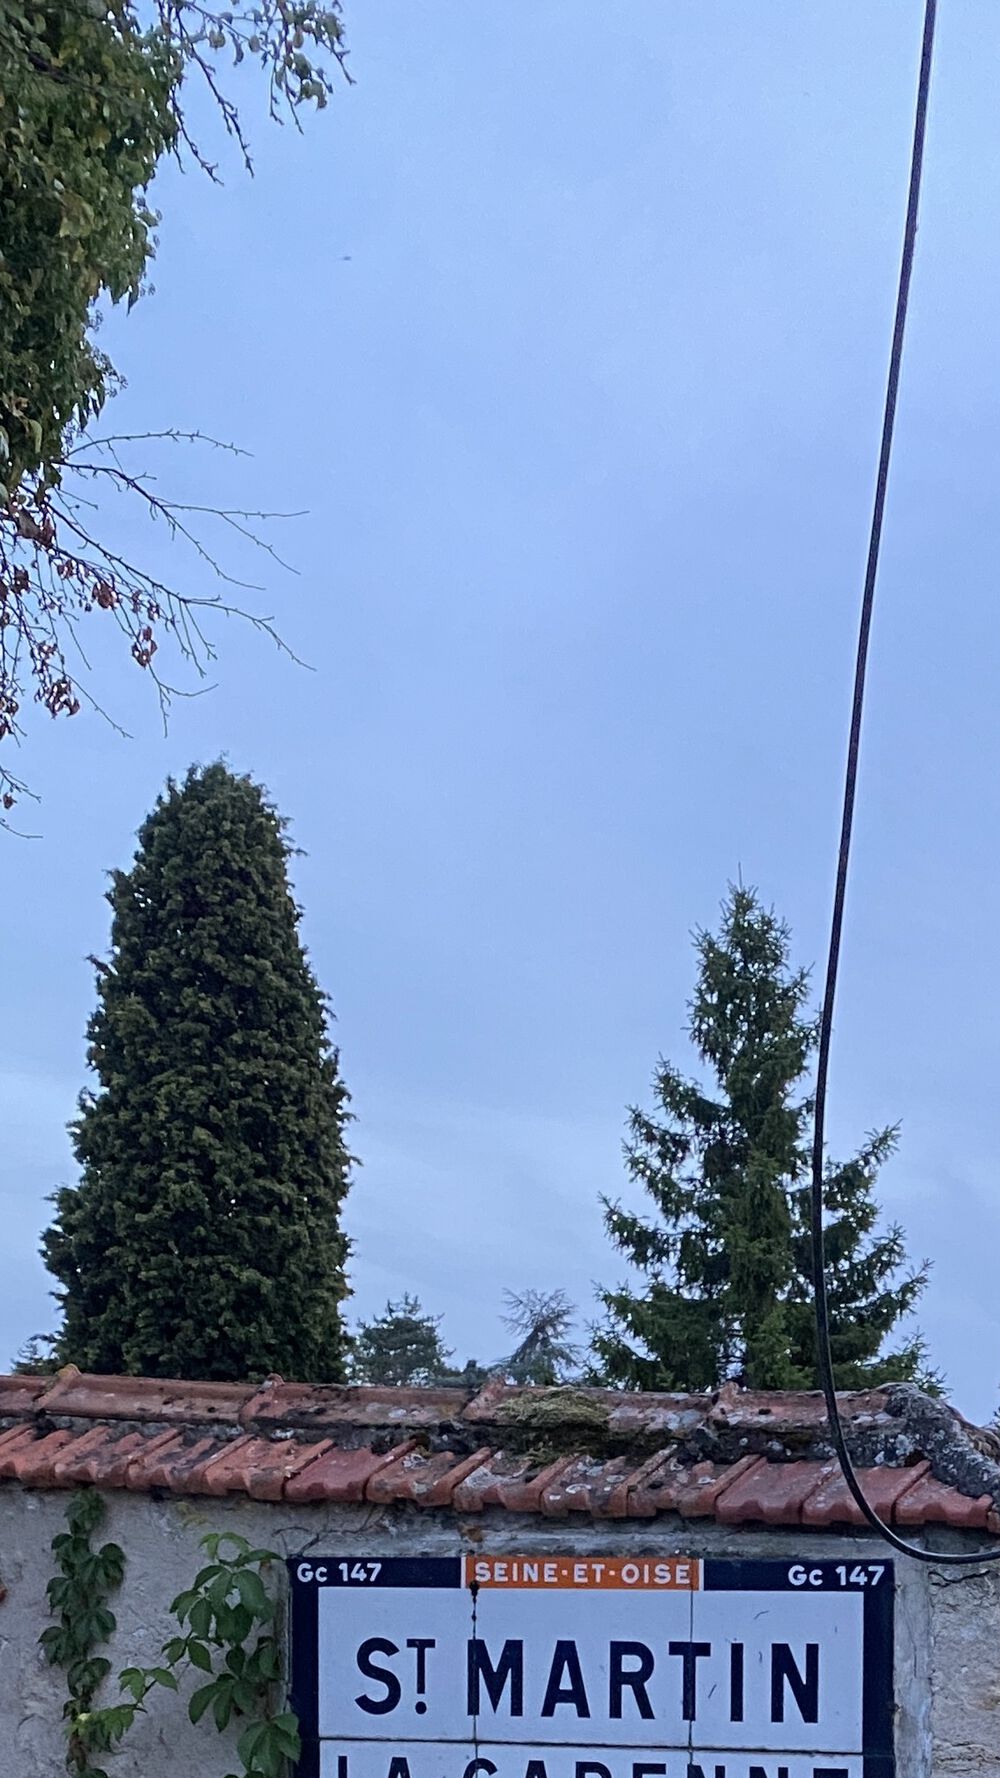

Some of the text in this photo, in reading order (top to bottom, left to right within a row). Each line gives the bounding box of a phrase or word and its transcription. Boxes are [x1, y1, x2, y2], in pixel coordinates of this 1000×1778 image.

[297, 1563, 382, 1582] Gc 147
[788, 1565, 885, 1586] Gc 147
[467, 1639, 820, 1723] MARTIN
